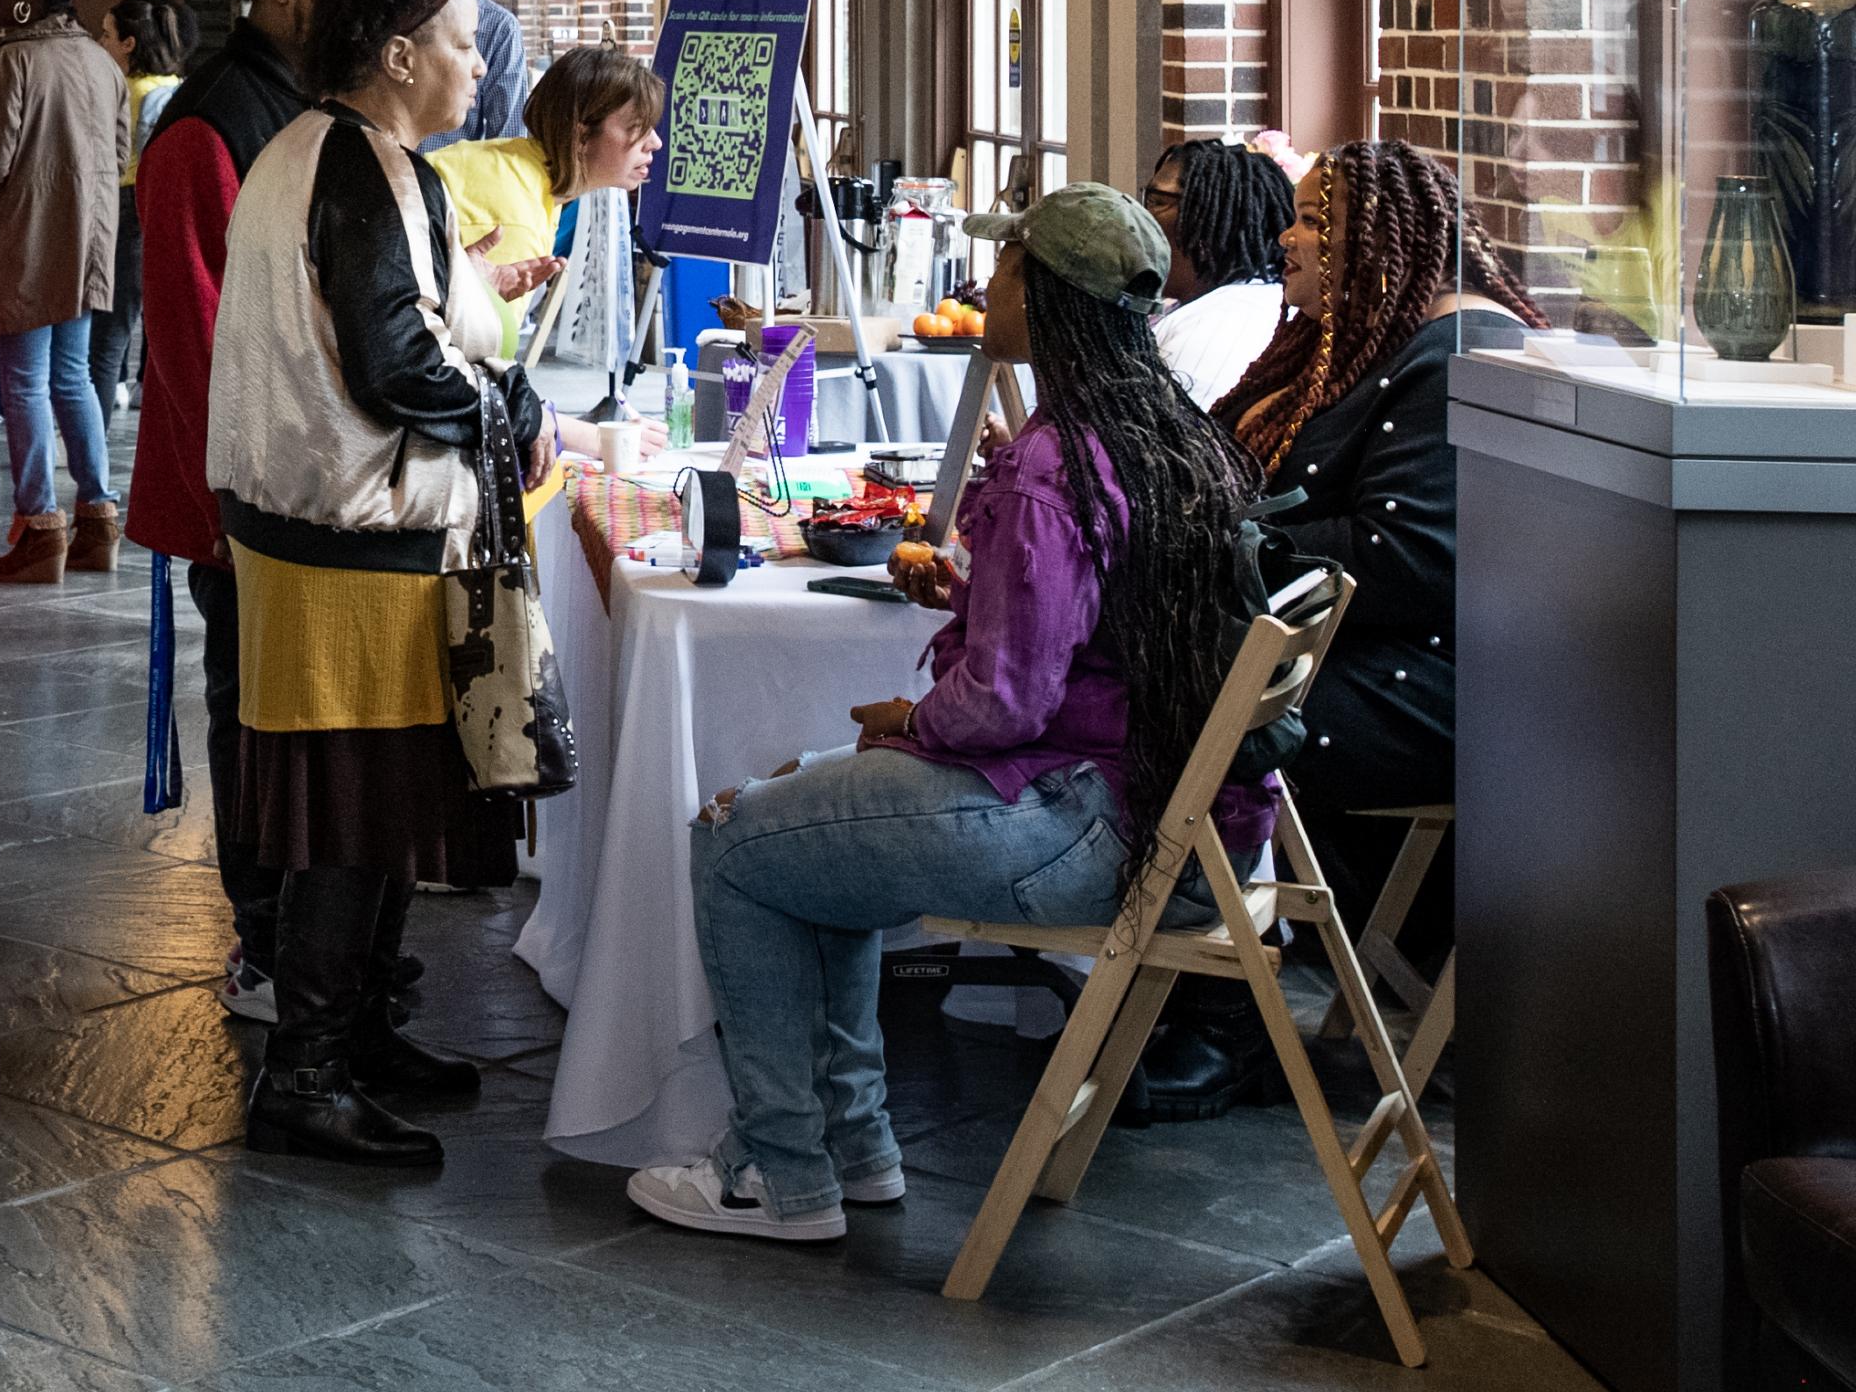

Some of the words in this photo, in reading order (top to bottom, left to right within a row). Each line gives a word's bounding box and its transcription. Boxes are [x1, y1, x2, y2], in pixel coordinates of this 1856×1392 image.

[668, 10, 685, 20] Scan
[686, 10, 697, 20] the
[698, 10, 710, 21] QR
[710, 11, 727, 21] code
[728, 10, 739, 21] for
[739, 13, 759, 21] more
